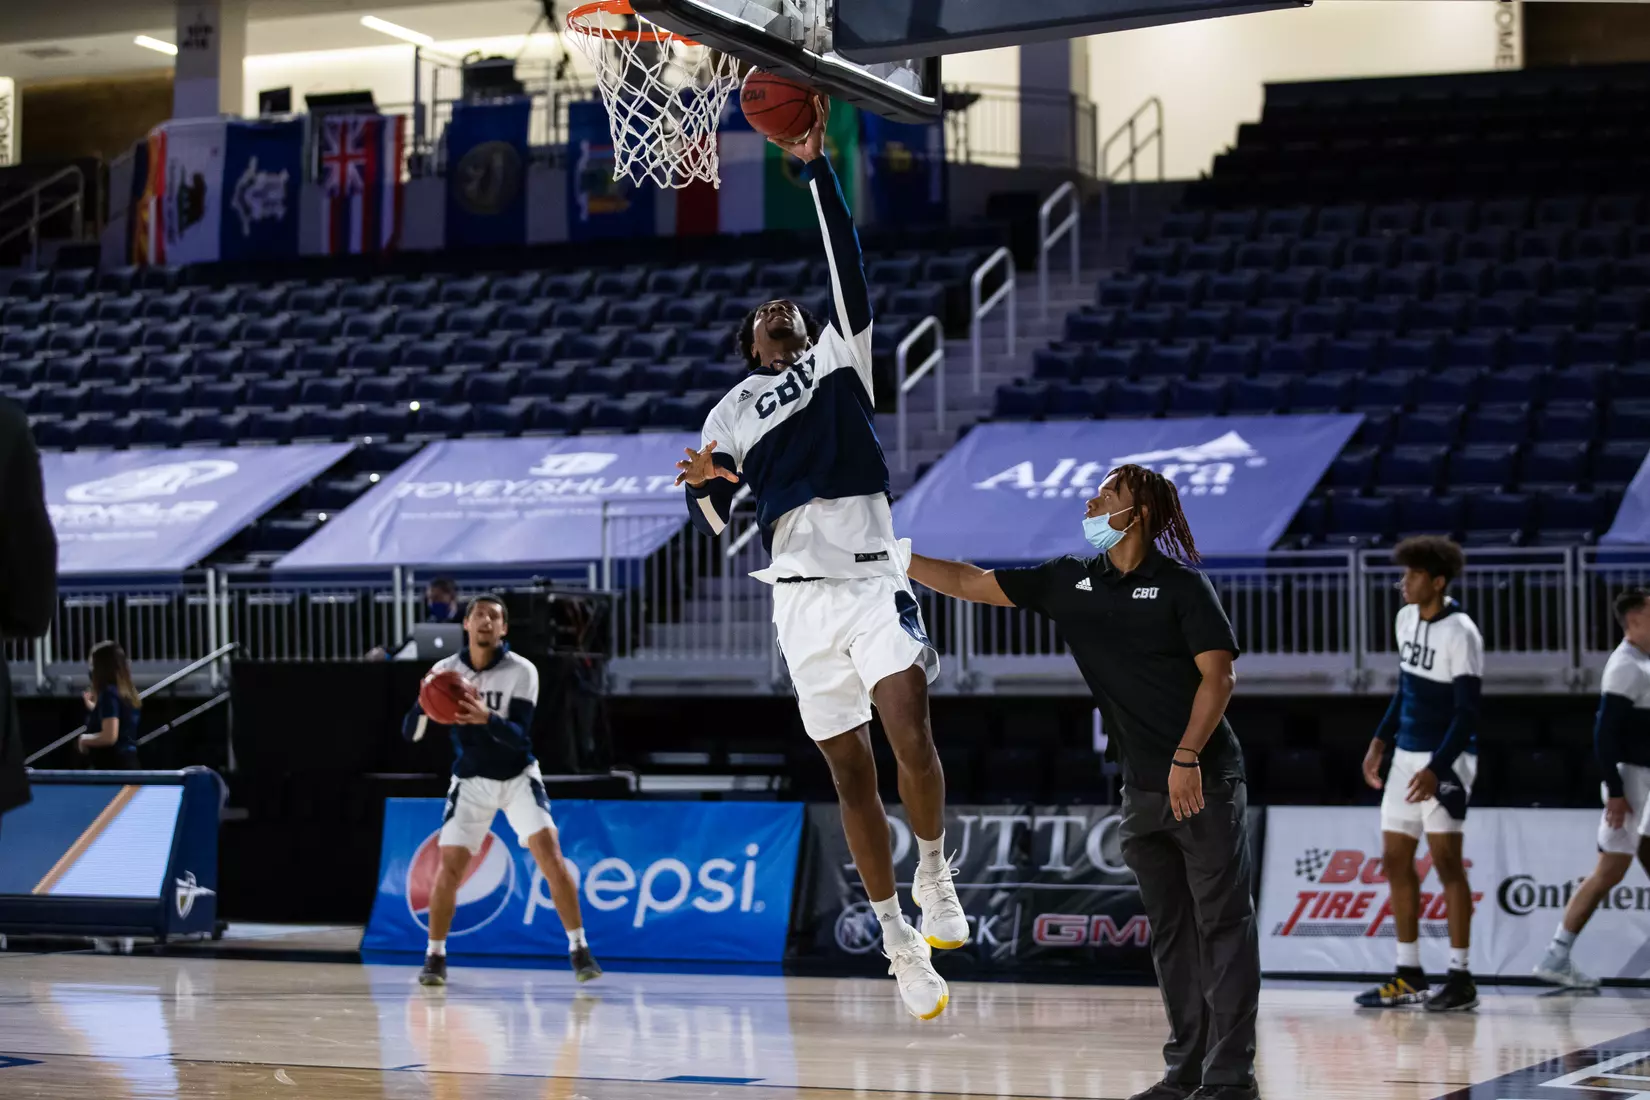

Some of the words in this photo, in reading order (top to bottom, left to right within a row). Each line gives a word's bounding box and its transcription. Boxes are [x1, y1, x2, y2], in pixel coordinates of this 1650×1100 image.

[755, 353, 816, 419] CBU
[973, 457, 1235, 489] Altra
[1132, 587, 1160, 599] CBU
[1400, 641, 1435, 671] CBU
[523, 843, 759, 928] pepsi
[1281, 891, 1377, 936] TIRE
